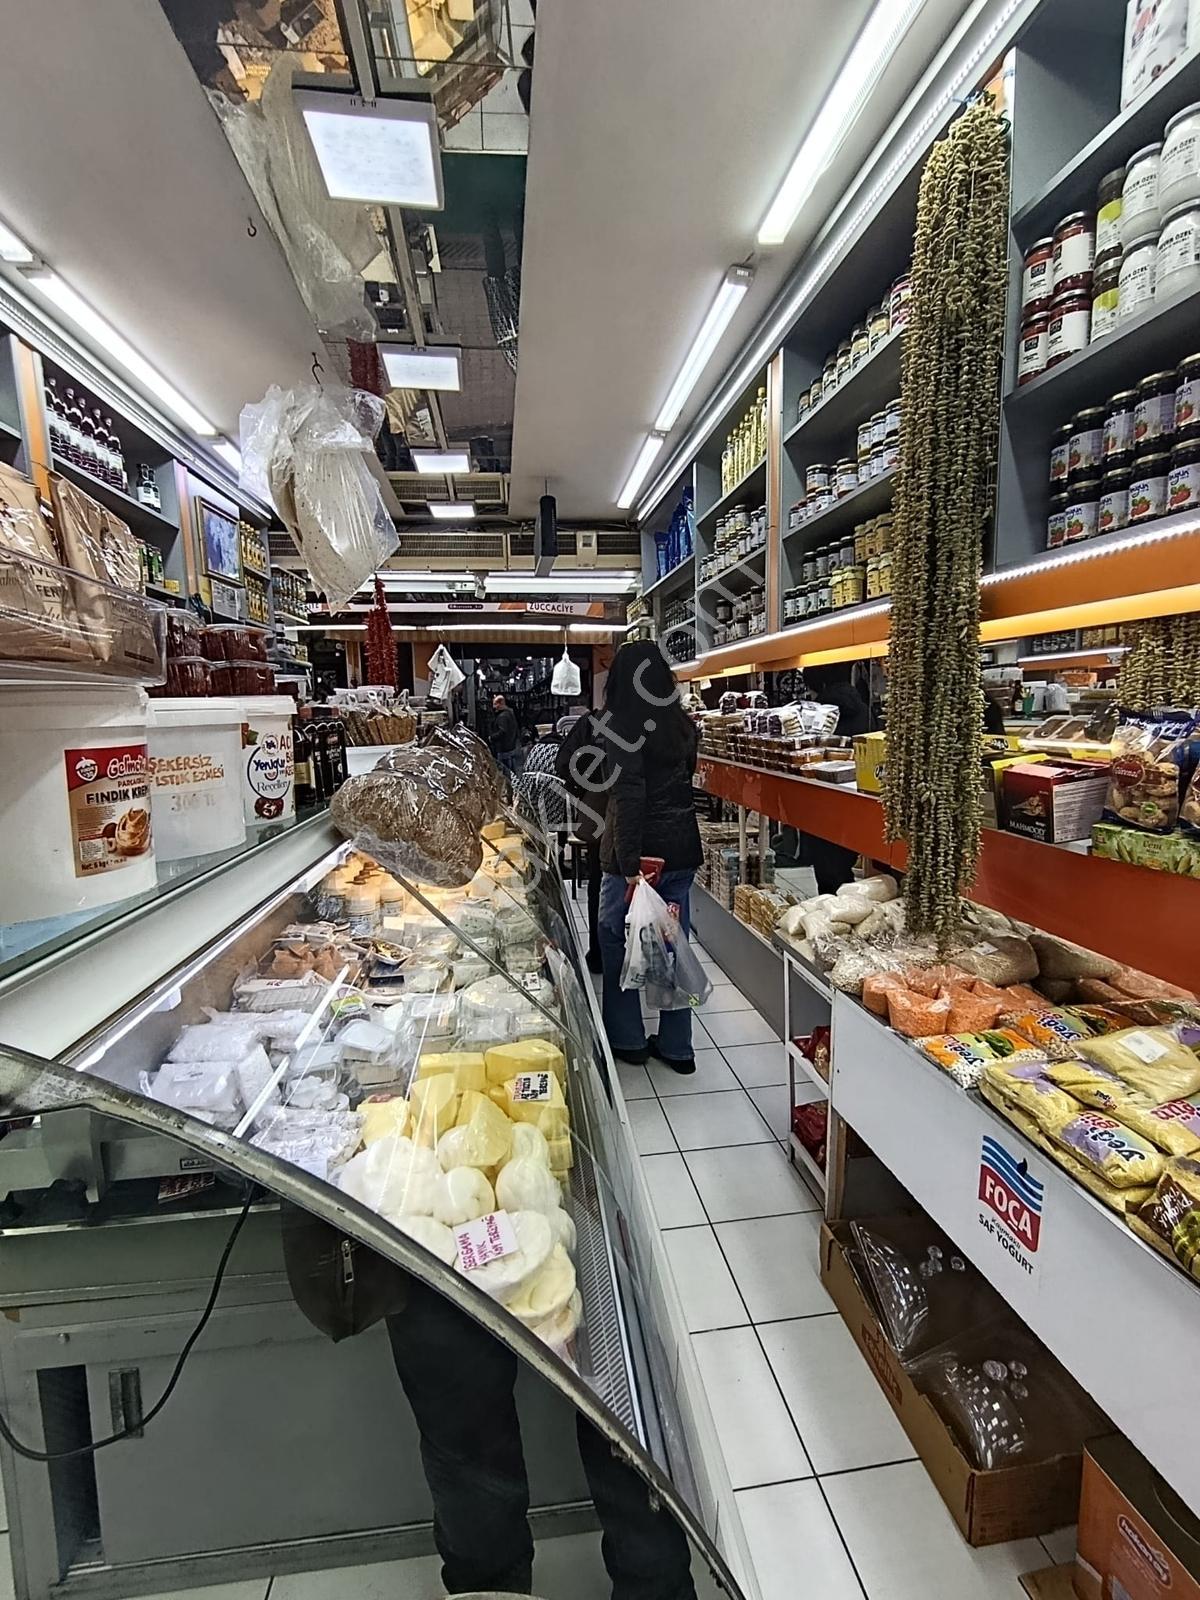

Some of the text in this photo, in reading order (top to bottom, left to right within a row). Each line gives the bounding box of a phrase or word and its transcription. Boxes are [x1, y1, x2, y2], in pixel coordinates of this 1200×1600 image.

[149, 754, 212, 775] ŞEKERSİZ
[86, 789, 130, 805] FINDIK
[1010, 820, 1046, 836] MAHMOOD
[1084, 1126, 1146, 1162] yedi
[985, 1175, 1033, 1241] FOÇA
[978, 1213, 996, 1234] SAF
